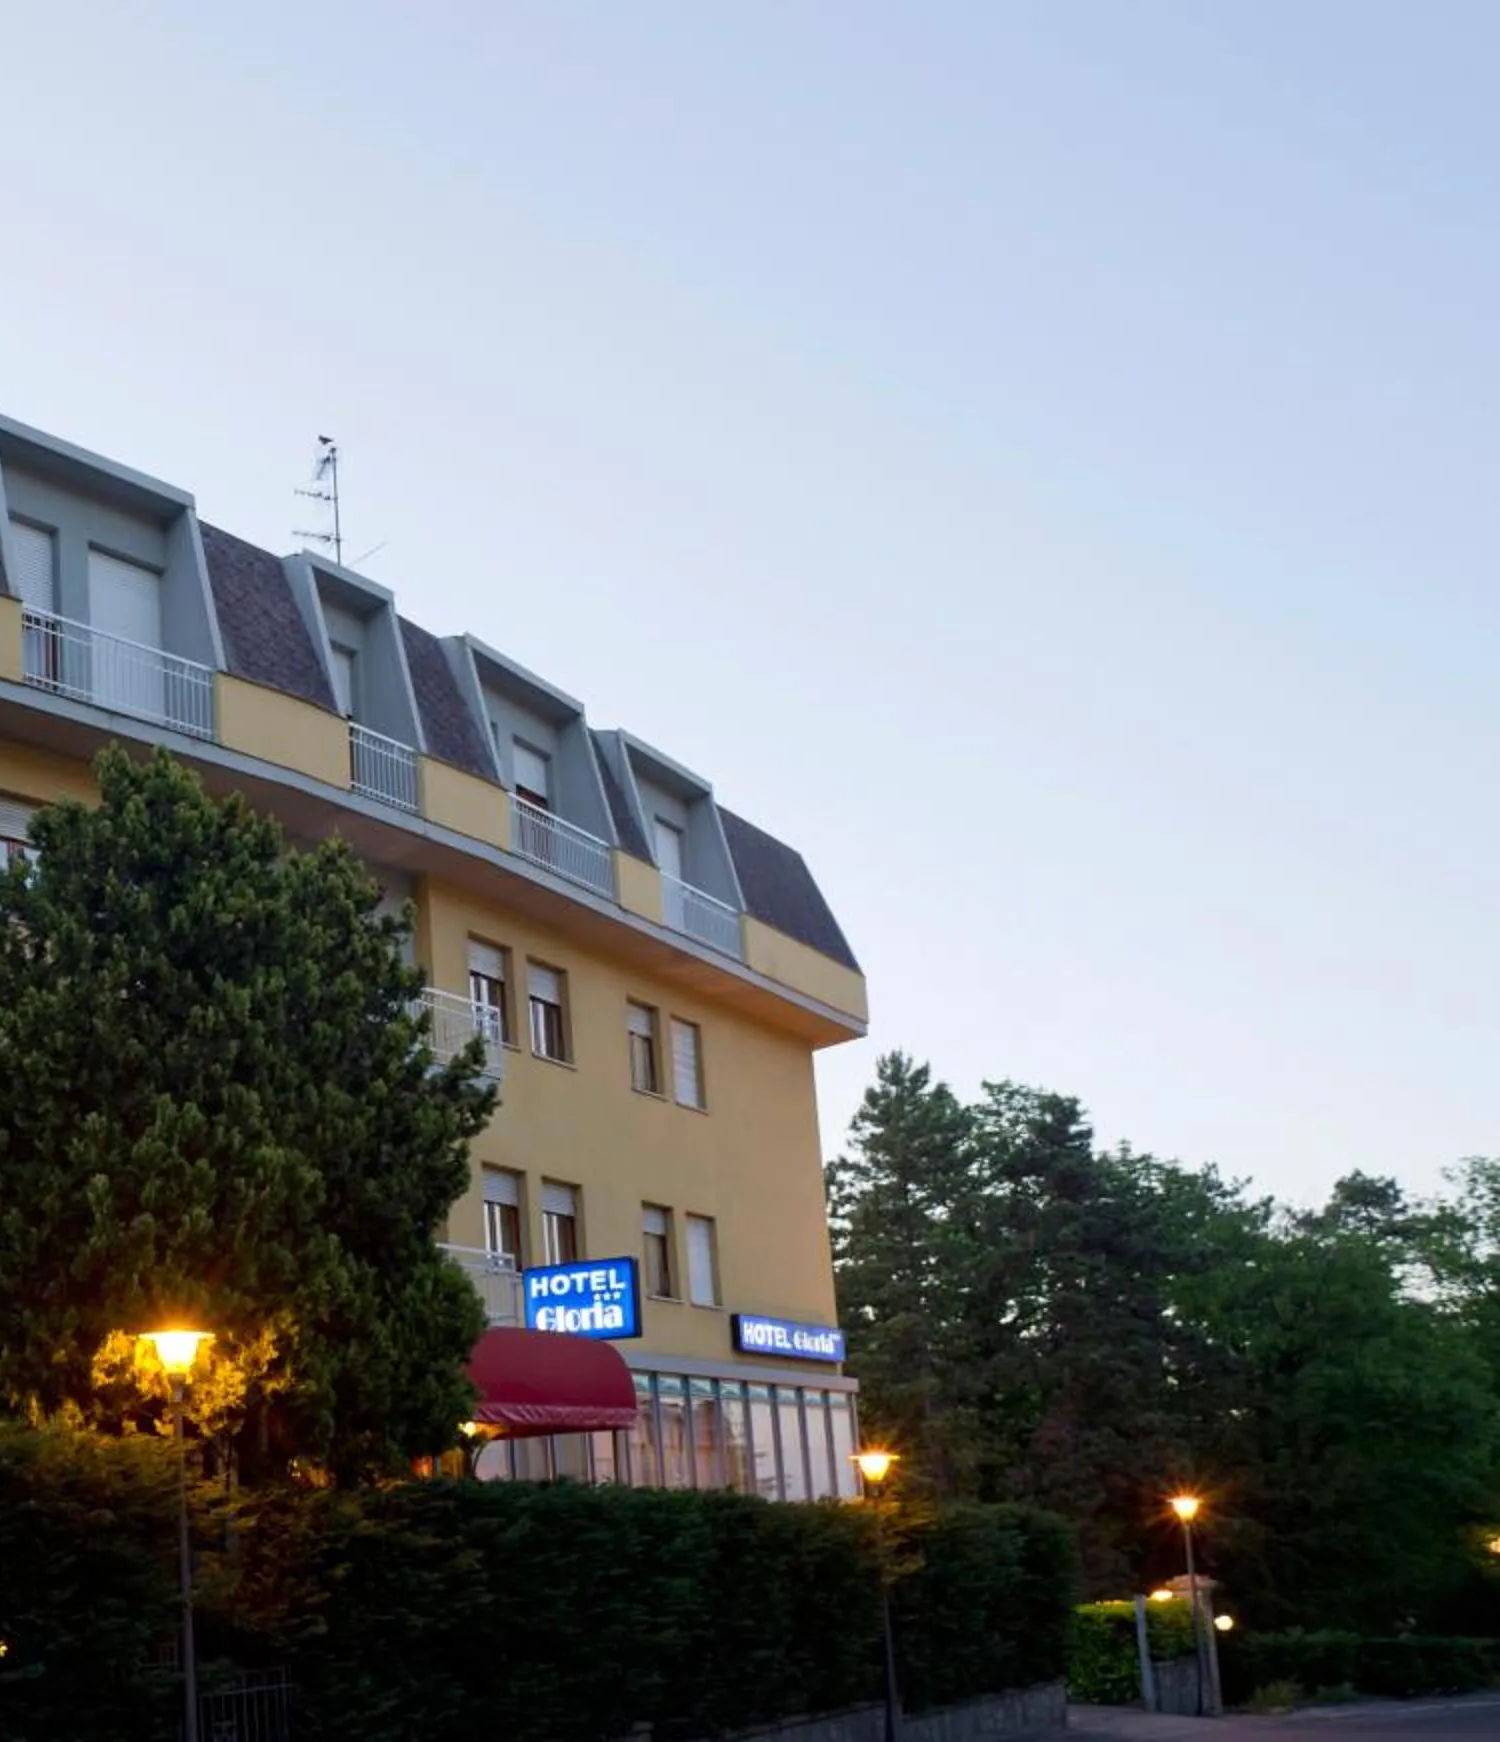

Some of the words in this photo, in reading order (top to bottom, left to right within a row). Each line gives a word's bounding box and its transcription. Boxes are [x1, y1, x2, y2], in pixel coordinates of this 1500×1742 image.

[531, 1268, 626, 1298] HOTEL
[535, 1301, 624, 1333] Gloria
[743, 1321, 791, 1349] HOTEL
